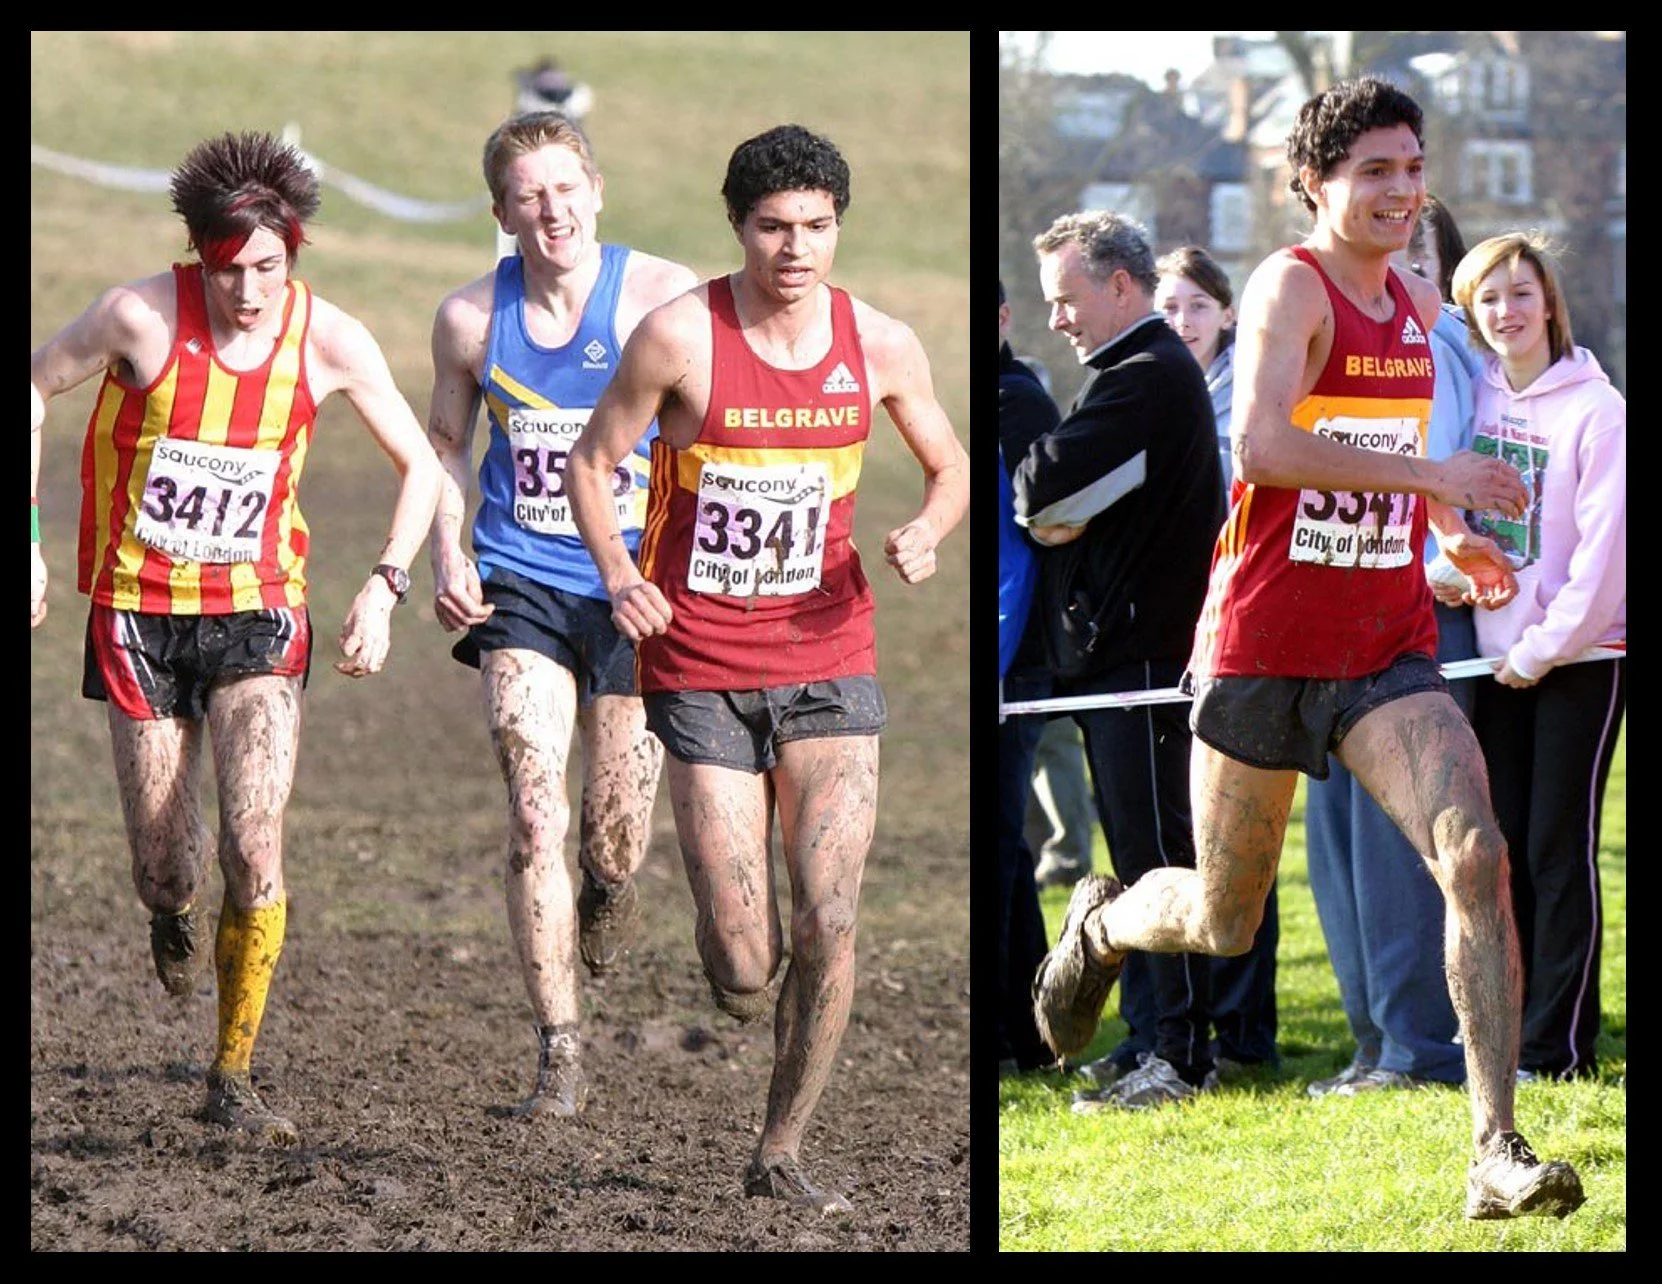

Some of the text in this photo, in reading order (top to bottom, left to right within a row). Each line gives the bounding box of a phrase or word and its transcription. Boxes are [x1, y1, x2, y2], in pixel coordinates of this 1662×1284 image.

[1345, 355, 1433, 378] BELGRAVE
[511, 420, 586, 434] saucon
[724, 406, 860, 428] BELGRAVE
[157, 446, 247, 476] saucony
[516, 448, 632, 498] 35
[703, 471, 797, 493] saucony
[146, 476, 268, 539] 3412
[516, 503, 566, 522] City of
[698, 502, 822, 560] 3341
[1295, 527, 1332, 553] City
[1336, 534, 1353, 553] of
[694, 559, 728, 583] City
[732, 569, 749, 585] of
